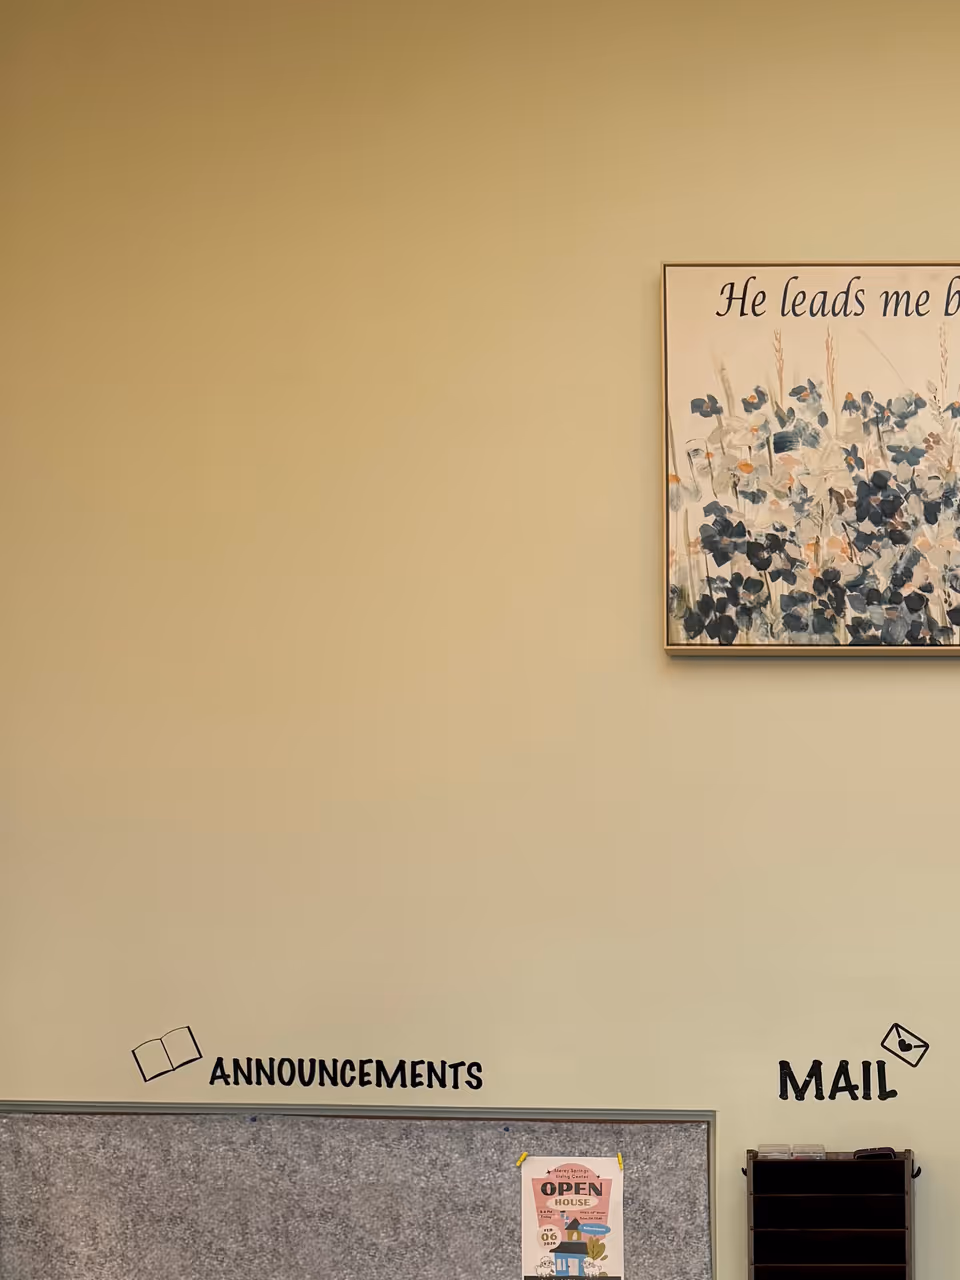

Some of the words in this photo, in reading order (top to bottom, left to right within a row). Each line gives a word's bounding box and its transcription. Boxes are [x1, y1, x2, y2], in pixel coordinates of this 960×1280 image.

[715, 275, 767, 317] He
[780, 275, 866, 317] leads
[879, 288, 931, 317] me
[209, 1056, 484, 1090] ANNOUNCEMENTS
[778, 1059, 898, 1101] MAIL
[540, 1181, 603, 1197] OPEN
[554, 1198, 591, 1207] HOUSE
[540, 1232, 558, 1242] 06
